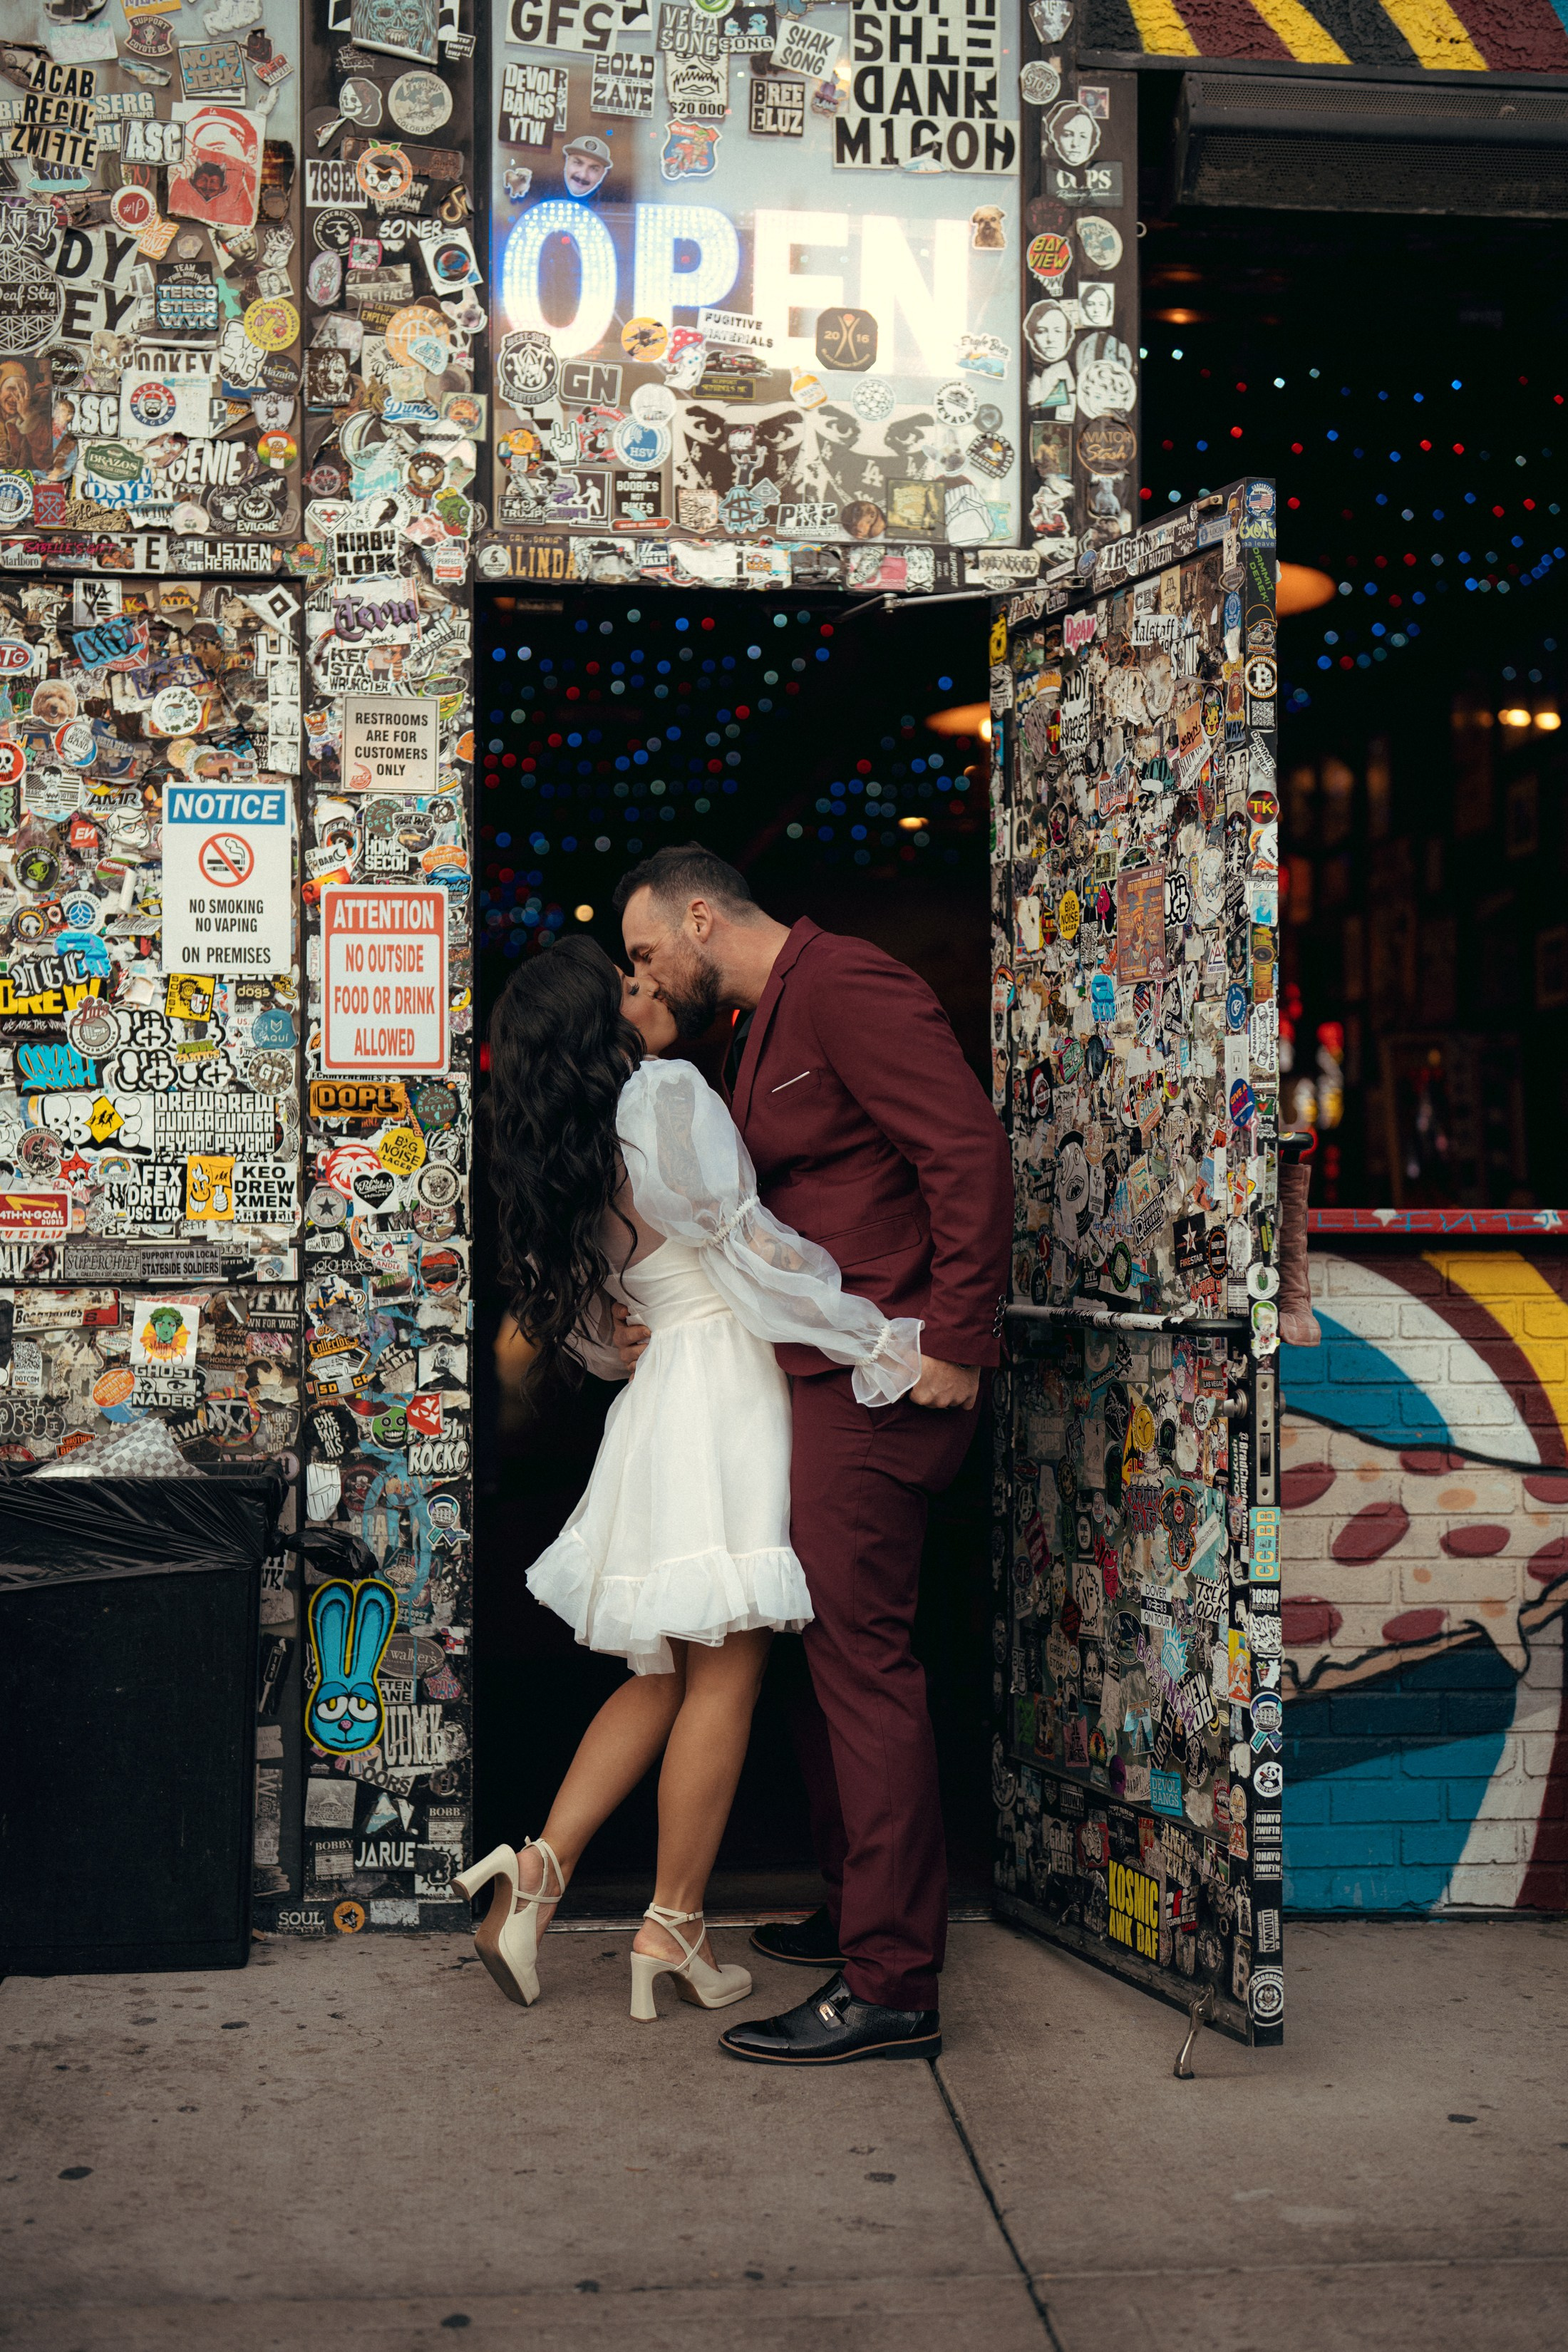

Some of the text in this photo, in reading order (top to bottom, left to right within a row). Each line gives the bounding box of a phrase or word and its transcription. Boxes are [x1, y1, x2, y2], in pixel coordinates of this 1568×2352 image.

[133, 16, 171, 31] SUPPORT
[129, 40, 158, 53] COYOTE
[660, 29, 718, 56] SONG
[719, 37, 775, 51] SONG
[786, 26, 835, 56] SHAK
[182, 44, 239, 70] NOPE
[257, 53, 287, 77] RED
[780, 46, 827, 76] SONG
[31, 61, 95, 99] ACAB
[186, 65, 244, 91] JERK
[504, 66, 556, 94] DEVOL
[1024, 73, 1053, 93] STOP
[753, 80, 804, 108] BREE
[96, 92, 154, 114] SERG
[502, 91, 555, 120] BANGS
[396, 116, 437, 135] COLORADO
[509, 117, 547, 145] YTW
[125, 120, 182, 163] ASC
[378, 219, 443, 239] SONER
[354, 237, 380, 247] PRESA
[1033, 236, 1065, 253] BAY
[173, 264, 196, 274] TEAM
[1028, 253, 1068, 270] VIEW
[158, 284, 218, 299] TERCO
[502, 199, 971, 376] OPEN
[27, 287, 56, 307] Stig
[158, 300, 218, 314] STESR
[361, 309, 393, 326] EMPIRE
[704, 312, 764, 331] FUGITIVE
[706, 327, 775, 349] MATERIALS
[824, 329, 870, 344] 20 16
[262, 364, 299, 383] Hazards
[137, 383, 172, 400] TEXAS
[252, 392, 294, 403] WONDER
[131, 403, 177, 427] RANGERS
[937, 398, 974, 425] NEVADA
[1082, 430, 1133, 443] AVIATOR
[629, 447, 656, 459] HSV
[1085, 443, 1130, 463] Stash
[88, 453, 139, 473] BRAZOS
[169, 440, 246, 486] GENIE
[627, 472, 648, 481] DUMP
[616, 480, 660, 492] BOOBIES
[630, 492, 646, 502] NOT
[501, 508, 542, 519] TRUMP
[621, 502, 655, 515] BIKES
[236, 520, 280, 532] EVILONE
[1177, 521, 1195, 535] ZORM
[24, 542, 83, 555] ISABELLE'S
[335, 530, 396, 552] KIRBY
[203, 542, 272, 559] LISTEN
[1148, 545, 1172, 567] BUZZIN
[1, 552, 39, 567] Marlboro
[203, 558, 272, 571] HEARNOW
[641, 555, 669, 567] TALK
[949, 551, 959, 587] SUPPORT
[1252, 547, 1275, 592] DAMMIT
[1249, 562, 1270, 604] DEREK!
[1135, 616, 1176, 641] falstaff
[356, 712, 428, 727] RESTROOMS
[366, 731, 416, 743] ARE FOR
[355, 746, 428, 760] CUSTOMERS
[376, 763, 406, 776] ONLY
[173, 794, 281, 820] NOTICE
[1249, 800, 1274, 815] TK
[189, 899, 264, 914] NO SMOKING
[333, 899, 435, 929] ATTENTION
[1064, 899, 1076, 914] BIG
[195, 917, 258, 933] NO VAPING
[1061, 910, 1079, 928] NOISE
[1062, 924, 1077, 933] LAGER
[182, 947, 271, 964] ON PREMISES
[346, 944, 424, 972] NO OUTSIDE
[237, 986, 270, 999] dogs
[334, 986, 435, 1014] FOOD OR DRINK
[71, 997, 110, 1026] Luis
[75, 1031, 118, 1055] TRANSMISSION
[354, 1028, 416, 1056] ALLOWED
[259, 1063, 284, 1082] GT
[311, 1072, 383, 1083] FCKMYENEMIES
[157, 1093, 213, 1111] DREW
[216, 1093, 274, 1112] DREW
[418, 1101, 455, 1113] DREAMS
[157, 1111, 213, 1131] GUMBA
[216, 1112, 274, 1131] GUMBA
[156, 1131, 214, 1152] PSYCHO
[215, 1132, 274, 1152] PSYCHO
[394, 1134, 418, 1154] BIG
[381, 1142, 421, 1167] NOISE
[382, 1154, 412, 1172] LAGER
[242, 1165, 287, 1179] KEO
[234, 1180, 295, 1195] DREW
[357, 1179, 395, 1195] Bleeders
[128, 1186, 182, 1207] DREW
[235, 1195, 293, 1208] XMEN
[67, 1251, 140, 1272] SUPERCHIEF
[142, 1249, 219, 1261] SUPPORT YOUR LOCAL
[1180, 1254, 1204, 1268] FIRESTAR
[142, 1261, 220, 1275] STATESIDE SOLDIERS
[373, 1259, 401, 1271] CANDLE
[1084, 1271, 1098, 1283] ATL
[263, 1318, 296, 1329] FOR WAR
[209, 1357, 247, 1366] HORSEMEN
[135, 1365, 196, 1379] GHOST
[132, 1394, 195, 1408] NADER
[262, 1412, 293, 1424] SMOKE
[265, 1422, 290, 1434] WEED
[270, 1432, 287, 1443] PET
[409, 1441, 470, 1474] ROCKO
[1145, 1584, 1167, 1599] DOVER
[1144, 1612, 1170, 1628] ON TOUR
[1049, 1644, 1066, 1661] GREAT
[1049, 1657, 1066, 1673] STORY
[1152, 1776, 1180, 1794] DEVOL-
[1152, 1792, 1180, 1808] BANGS
[1256, 1813, 1281, 1824] OHAYO
[1255, 1826, 1281, 1835] ZWIFTR
[316, 1839, 354, 1852] BOBBY
[354, 1841, 416, 1869] JARUE
[1256, 1852, 1281, 1862] OHAYO
[1108, 1858, 1159, 1929] KOSMIC
[278, 1910, 325, 1927] SOUL
[1109, 1907, 1159, 1961] AWK DAF
